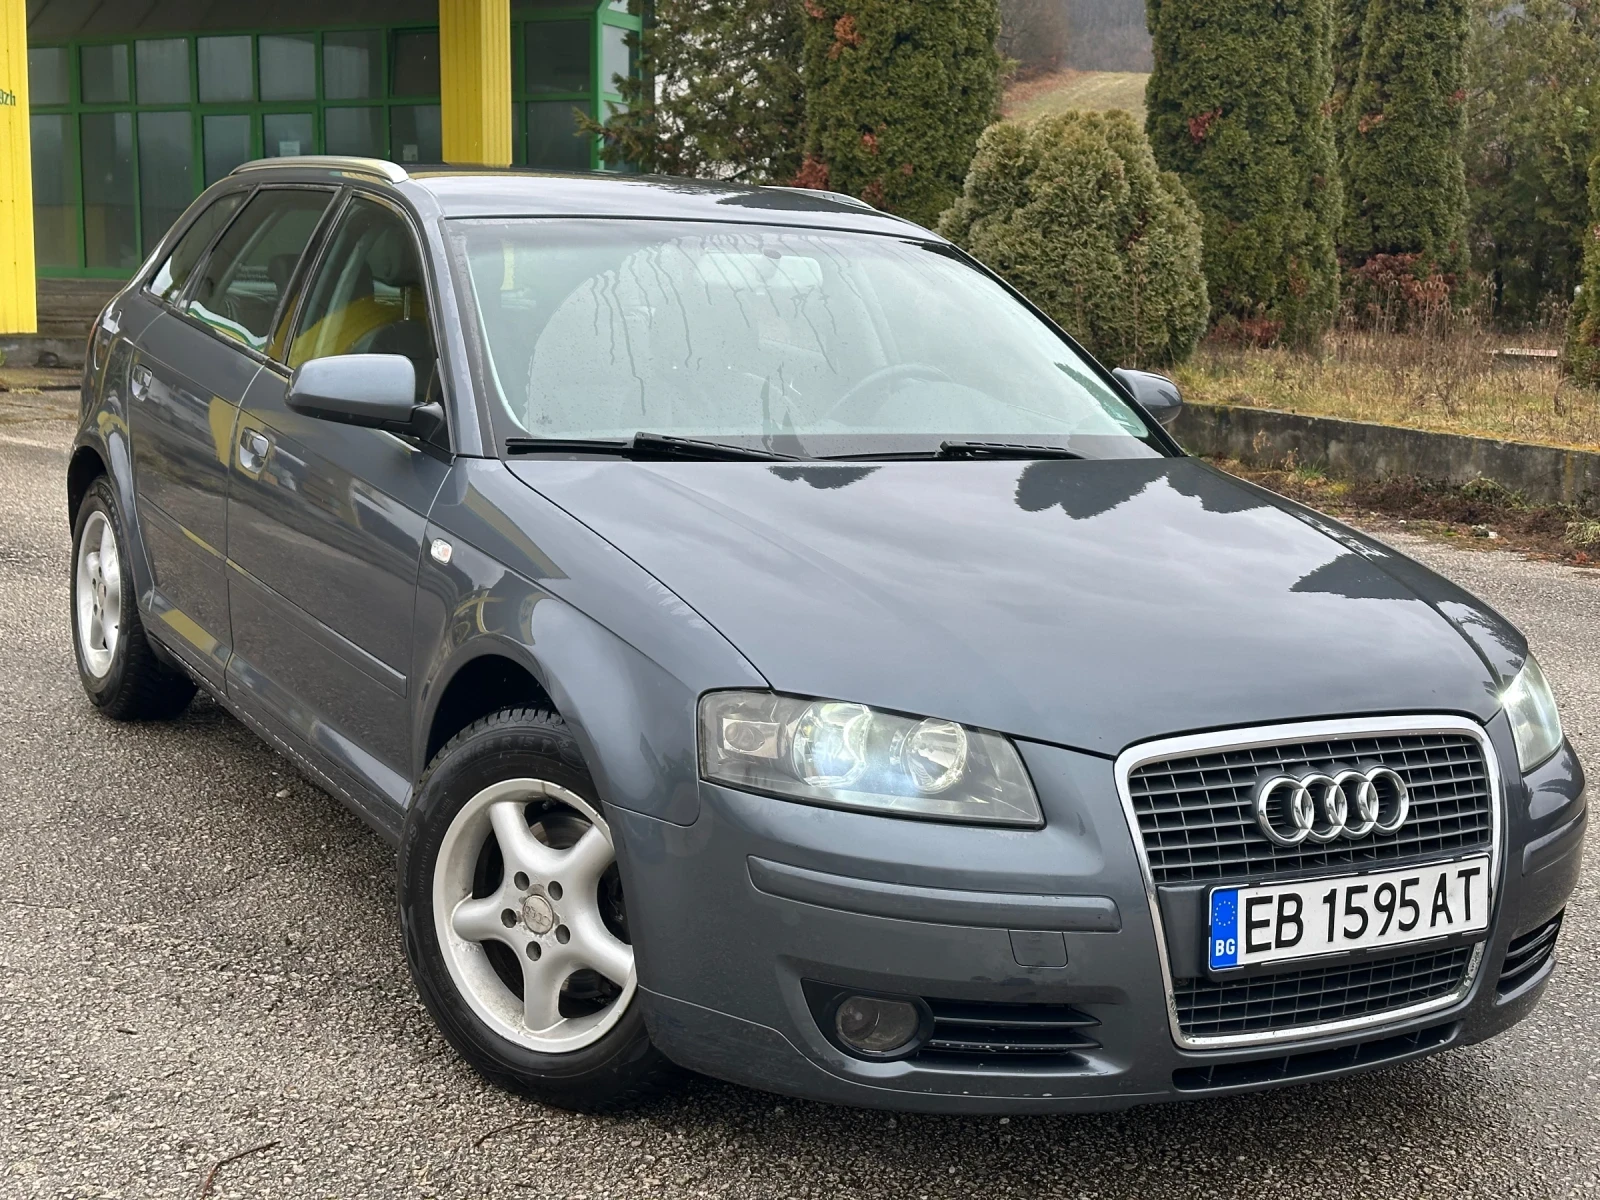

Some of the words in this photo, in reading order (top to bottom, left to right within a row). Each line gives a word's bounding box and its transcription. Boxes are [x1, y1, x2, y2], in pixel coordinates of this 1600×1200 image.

[1245, 892, 1304, 954] EB
[1322, 877, 1420, 942] 1595
[1430, 867, 1481, 927] AT
[1215, 938, 1236, 957] BG
